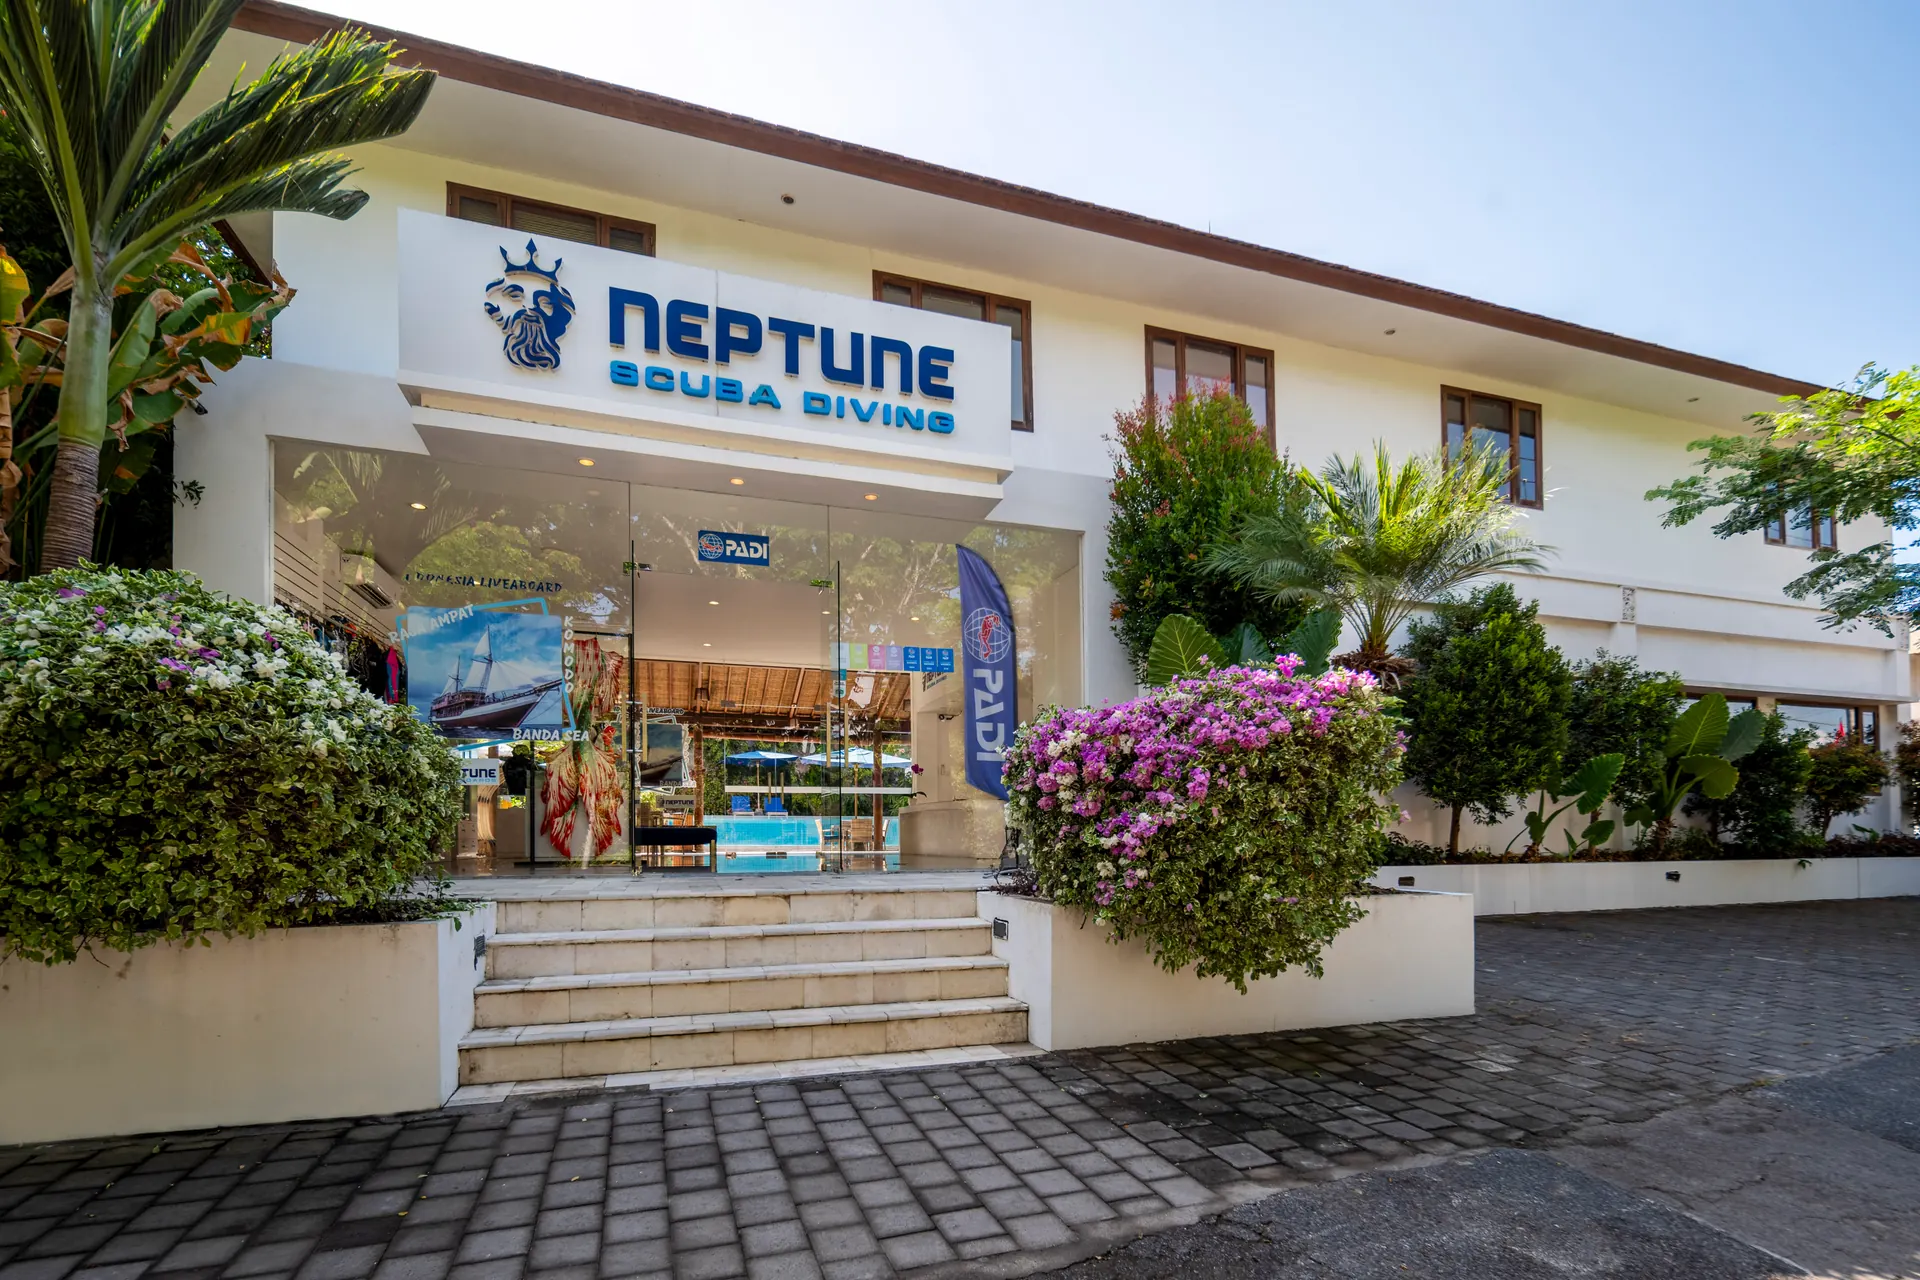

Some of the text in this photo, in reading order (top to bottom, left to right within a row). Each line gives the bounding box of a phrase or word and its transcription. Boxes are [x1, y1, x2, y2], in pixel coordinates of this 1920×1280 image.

[609, 286, 954, 401] NEPTUNE
[609, 360, 955, 434] SCUBA DIVING
[726, 540, 768, 559] PADI
[405, 571, 562, 592] IDONESIA LIVEABOARD
[430, 604, 474, 629] AMPAT
[563, 615, 575, 693] KOMODO
[512, 727, 590, 742] BANDA SEA
[973, 668, 1005, 761] PADI
